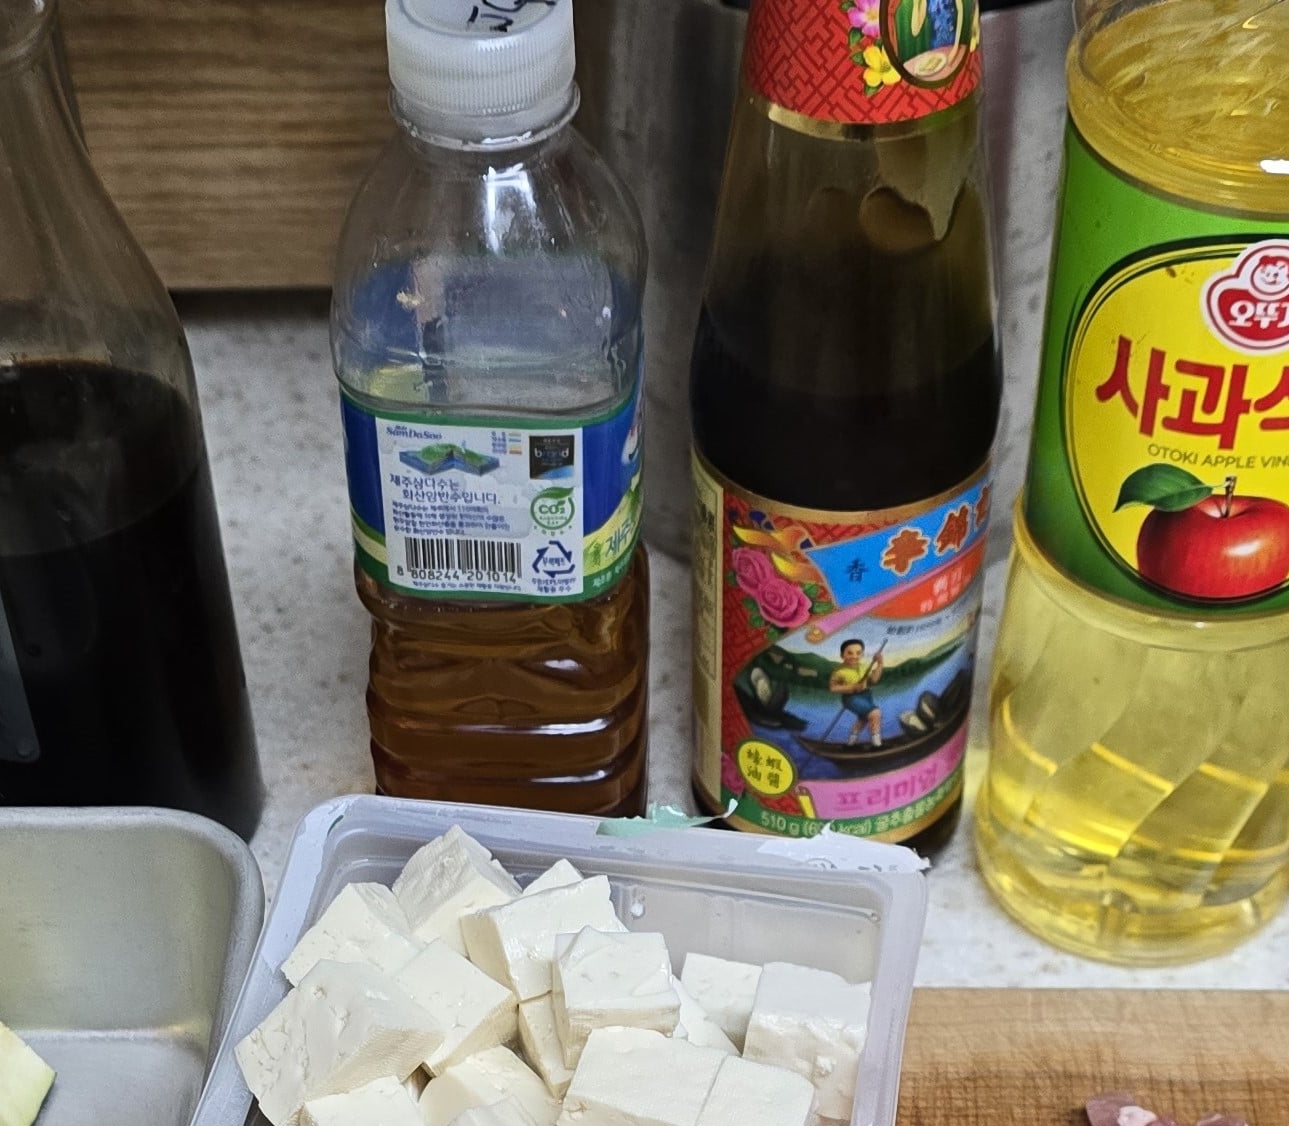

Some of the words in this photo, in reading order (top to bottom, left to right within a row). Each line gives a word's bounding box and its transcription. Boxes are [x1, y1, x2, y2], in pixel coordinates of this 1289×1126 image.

[1147, 443, 1198, 465] OTOKI
[1201, 453, 1255, 469] APPLE
[396, 565, 405, 576] 8
[411, 568, 460, 581] 808244
[467, 571, 517, 584] 201014
[761, 811, 787, 831] 510
[788, 821, 801, 836] g
